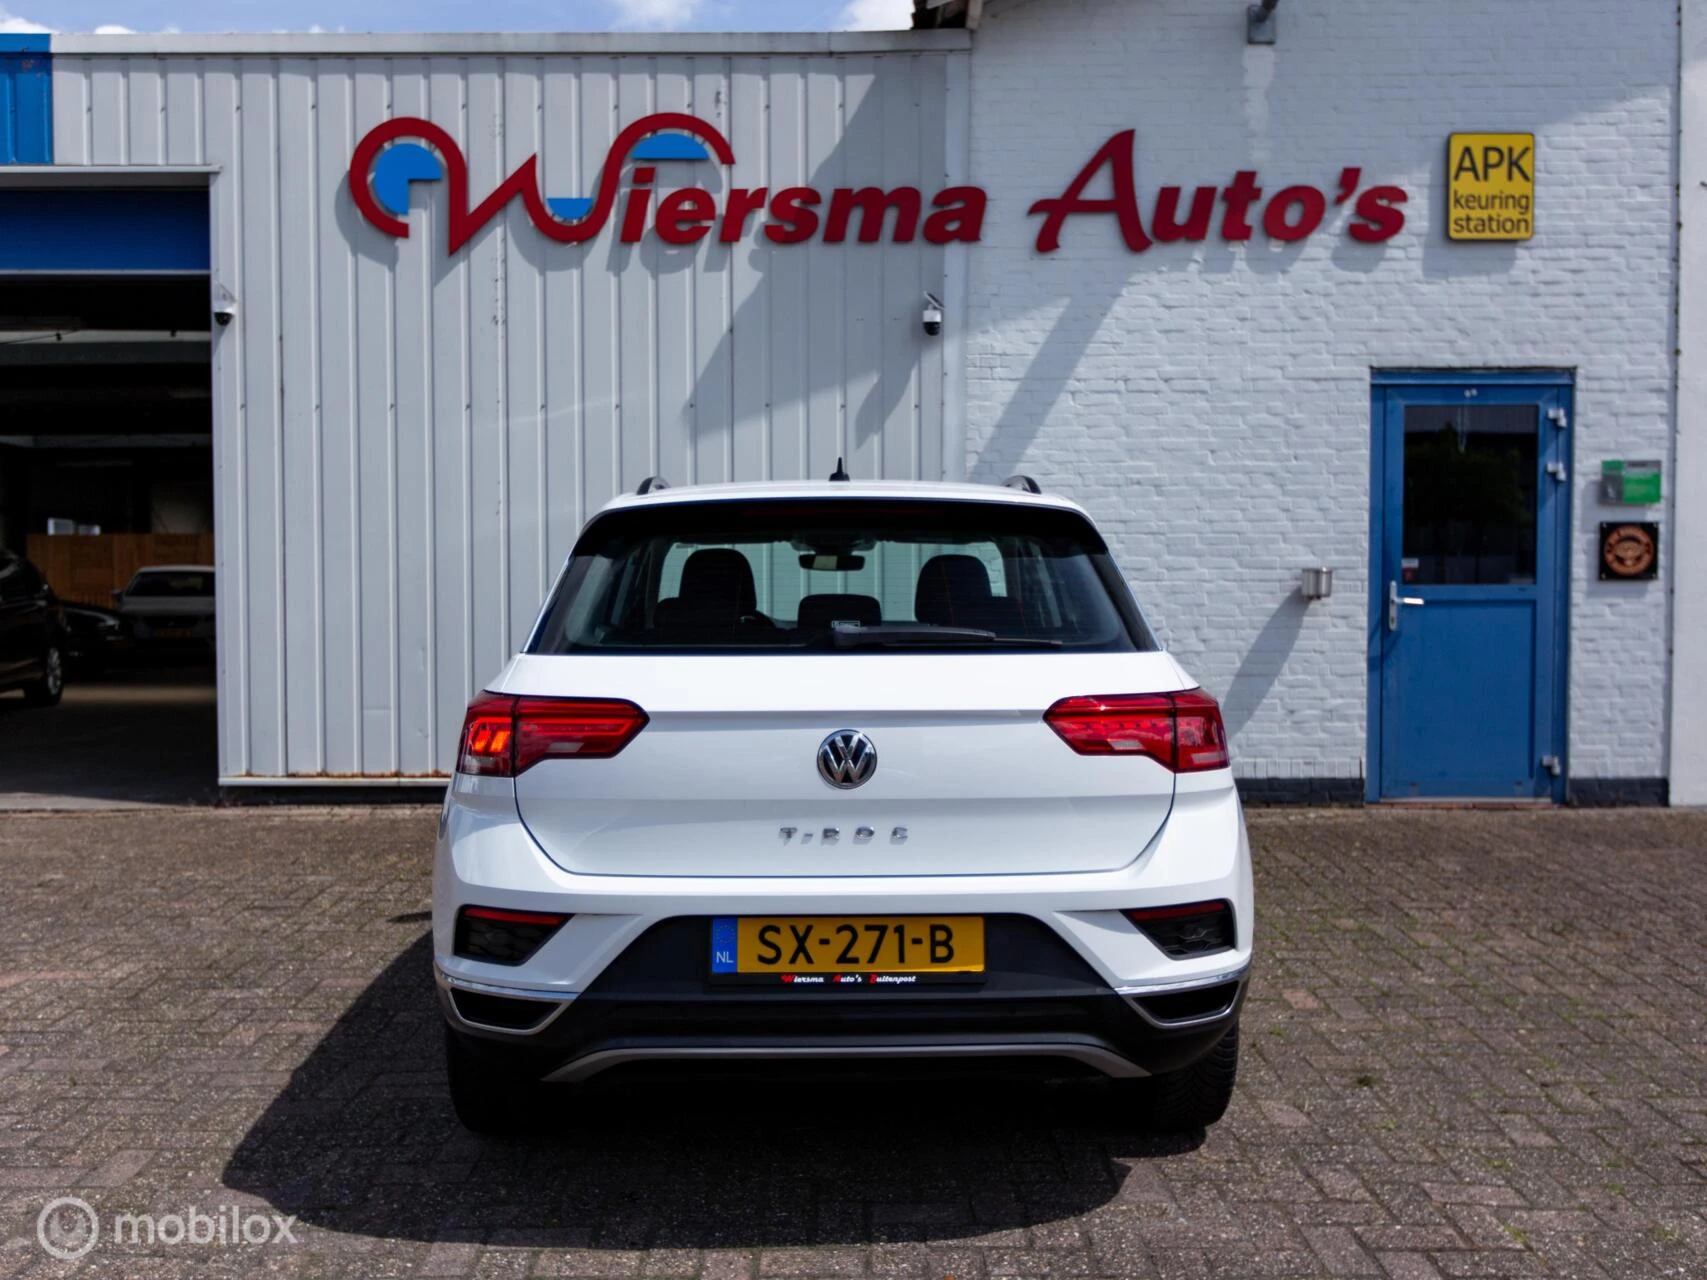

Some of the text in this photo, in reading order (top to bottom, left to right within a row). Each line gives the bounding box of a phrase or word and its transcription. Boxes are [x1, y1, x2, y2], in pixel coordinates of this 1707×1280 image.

[1453, 146, 1531, 182] APK
[349, 112, 1409, 256] Wiersma Auto's
[1453, 189, 1530, 216] keuring
[1453, 215, 1530, 234] station
[817, 729, 877, 789] VW
[716, 951, 734, 963] NL
[757, 924, 954, 965] SX-271-B
[781, 974, 917, 984] Wiersma Auto's Buitenpost
